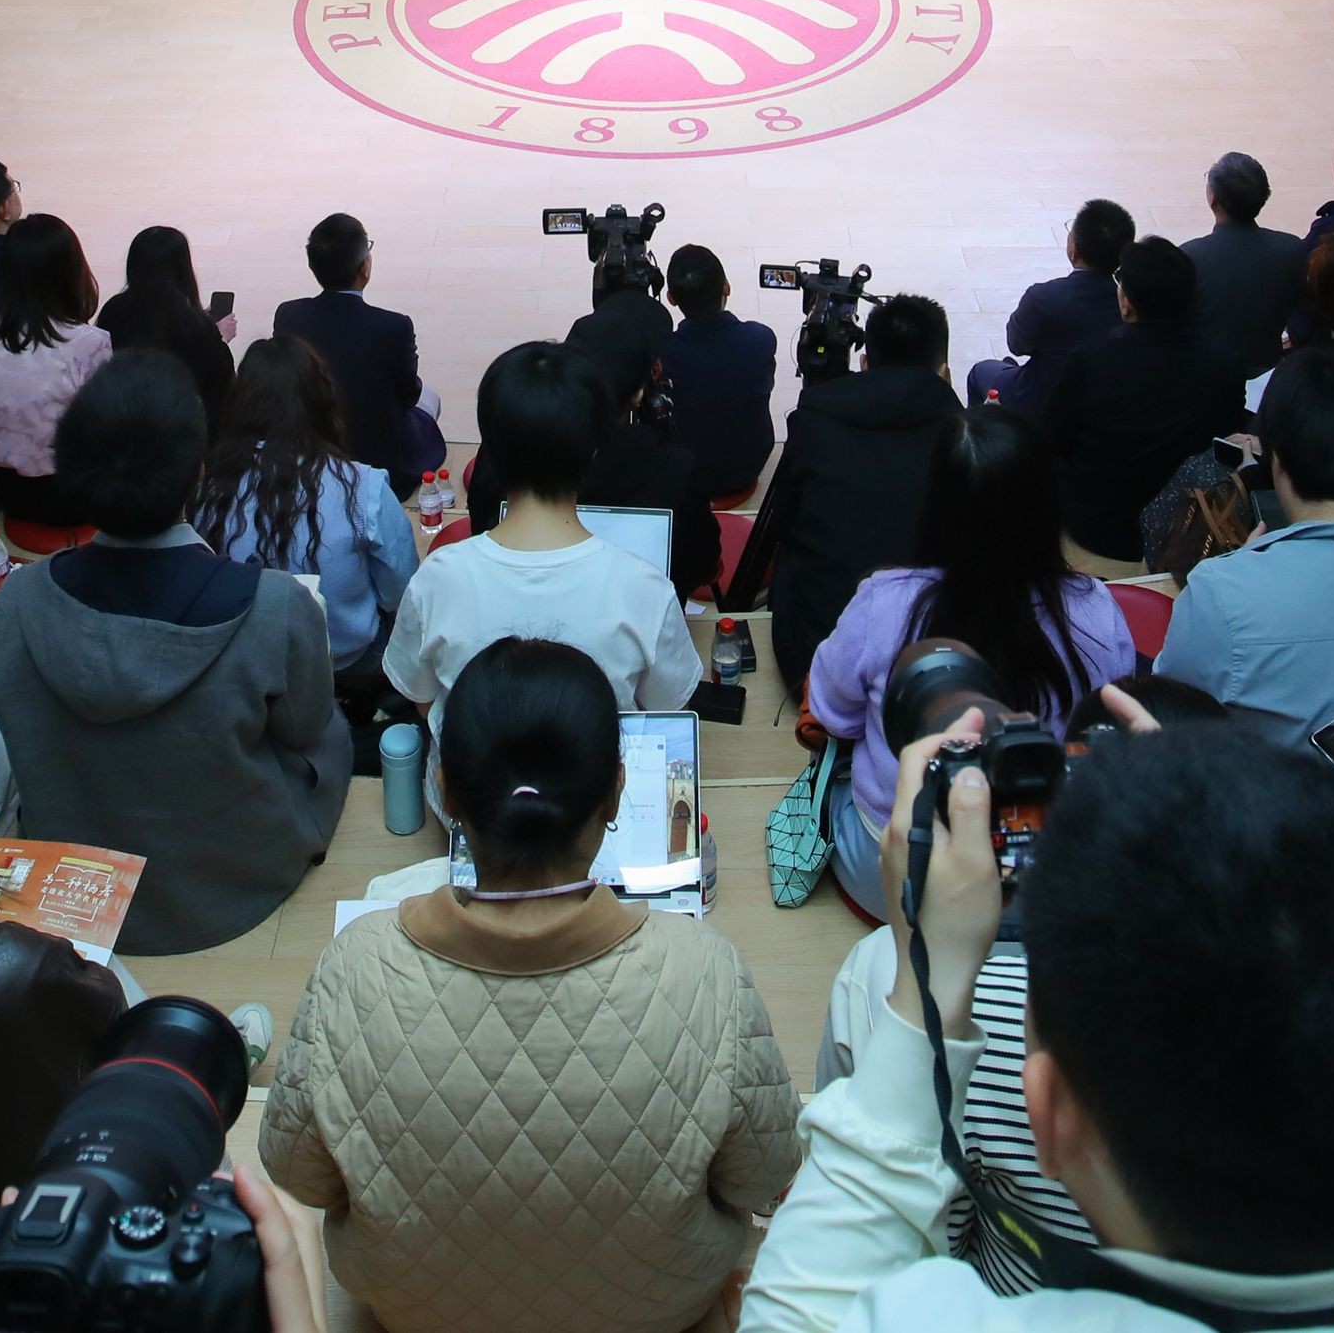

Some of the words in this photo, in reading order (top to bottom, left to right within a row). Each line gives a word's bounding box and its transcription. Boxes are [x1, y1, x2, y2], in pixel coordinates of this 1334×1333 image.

[476, 105, 803, 144] 1898
[42, 873, 115, 899] 另一种栖居
